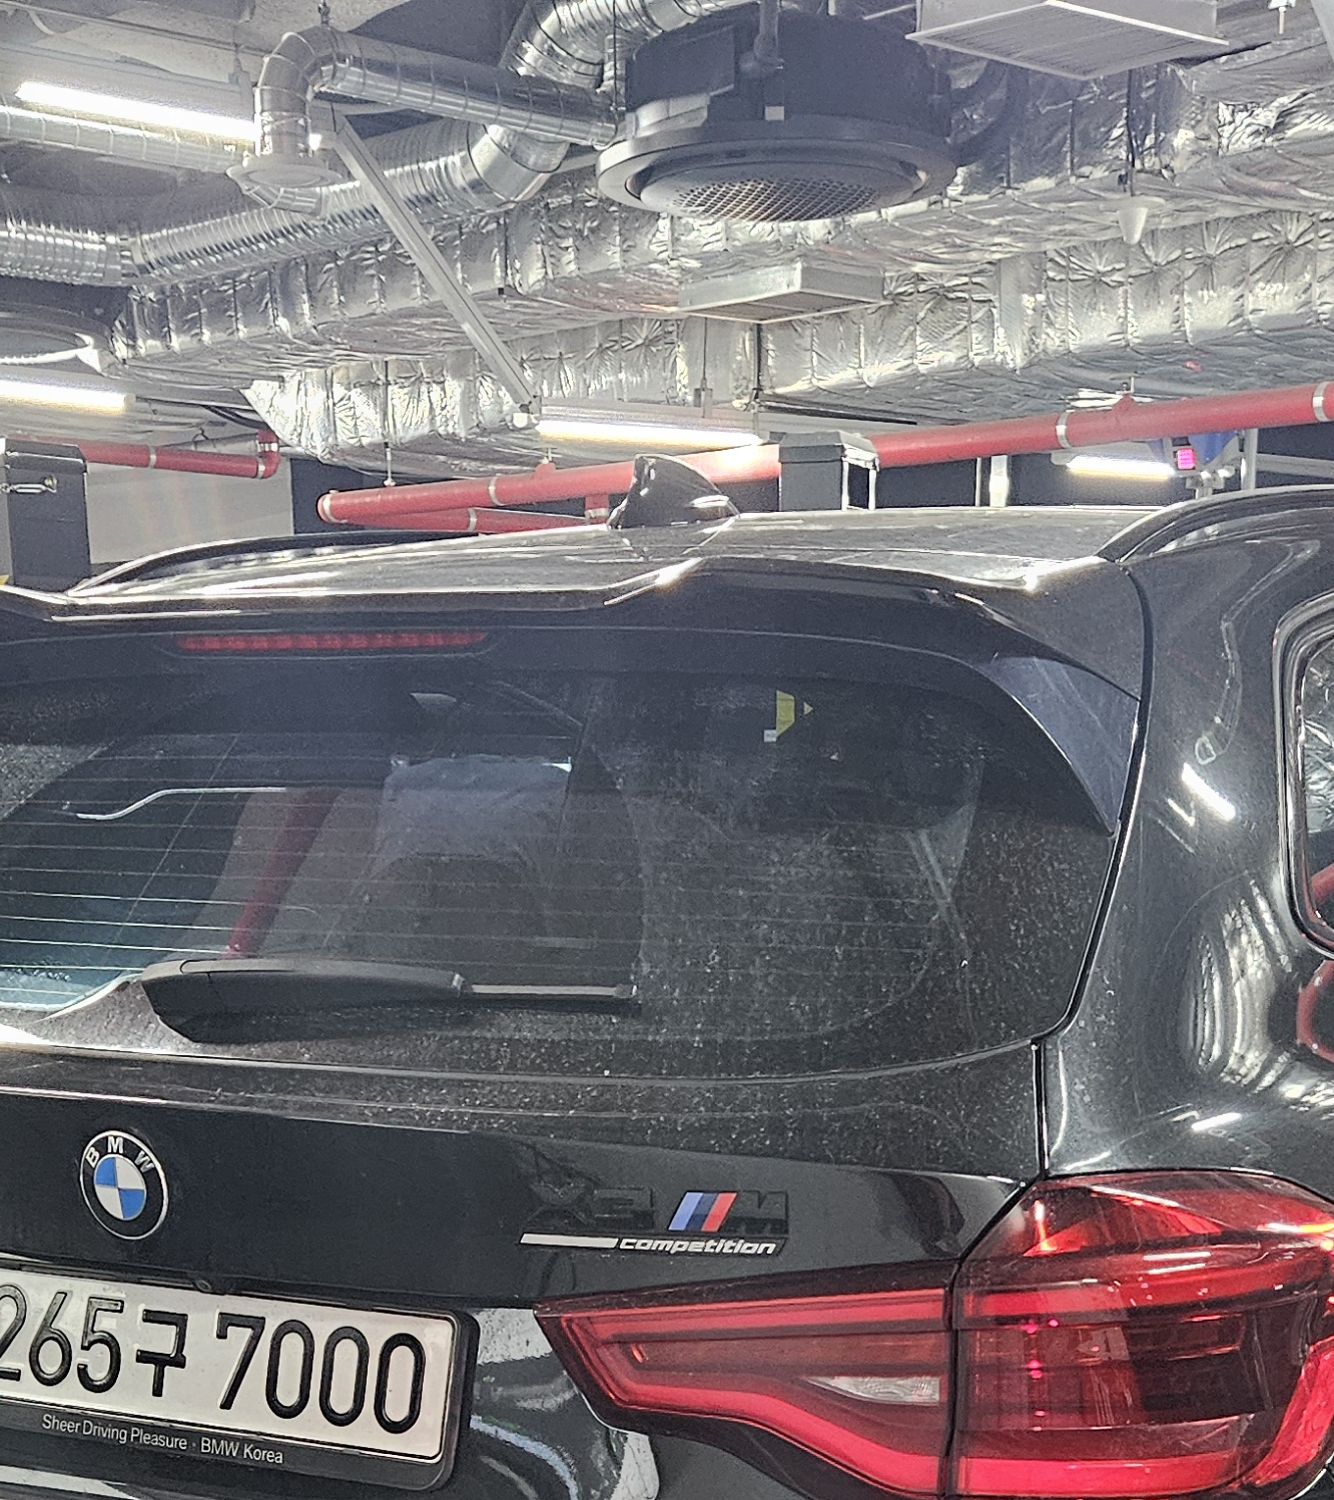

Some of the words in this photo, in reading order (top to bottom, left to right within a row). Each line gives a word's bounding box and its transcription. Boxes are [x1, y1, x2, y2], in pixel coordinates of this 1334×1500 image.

[84, 1135, 154, 1173] BMW
[619, 1236, 776, 1255] competition
[215, 1311, 426, 1434] 7000
[41, 1413, 80, 1434] Sheer
[82, 1419, 128, 1446] Driving
[130, 1425, 188, 1451] Pleasure
[200, 1436, 240, 1457] BMW
[242, 1443, 284, 1464] Korea
